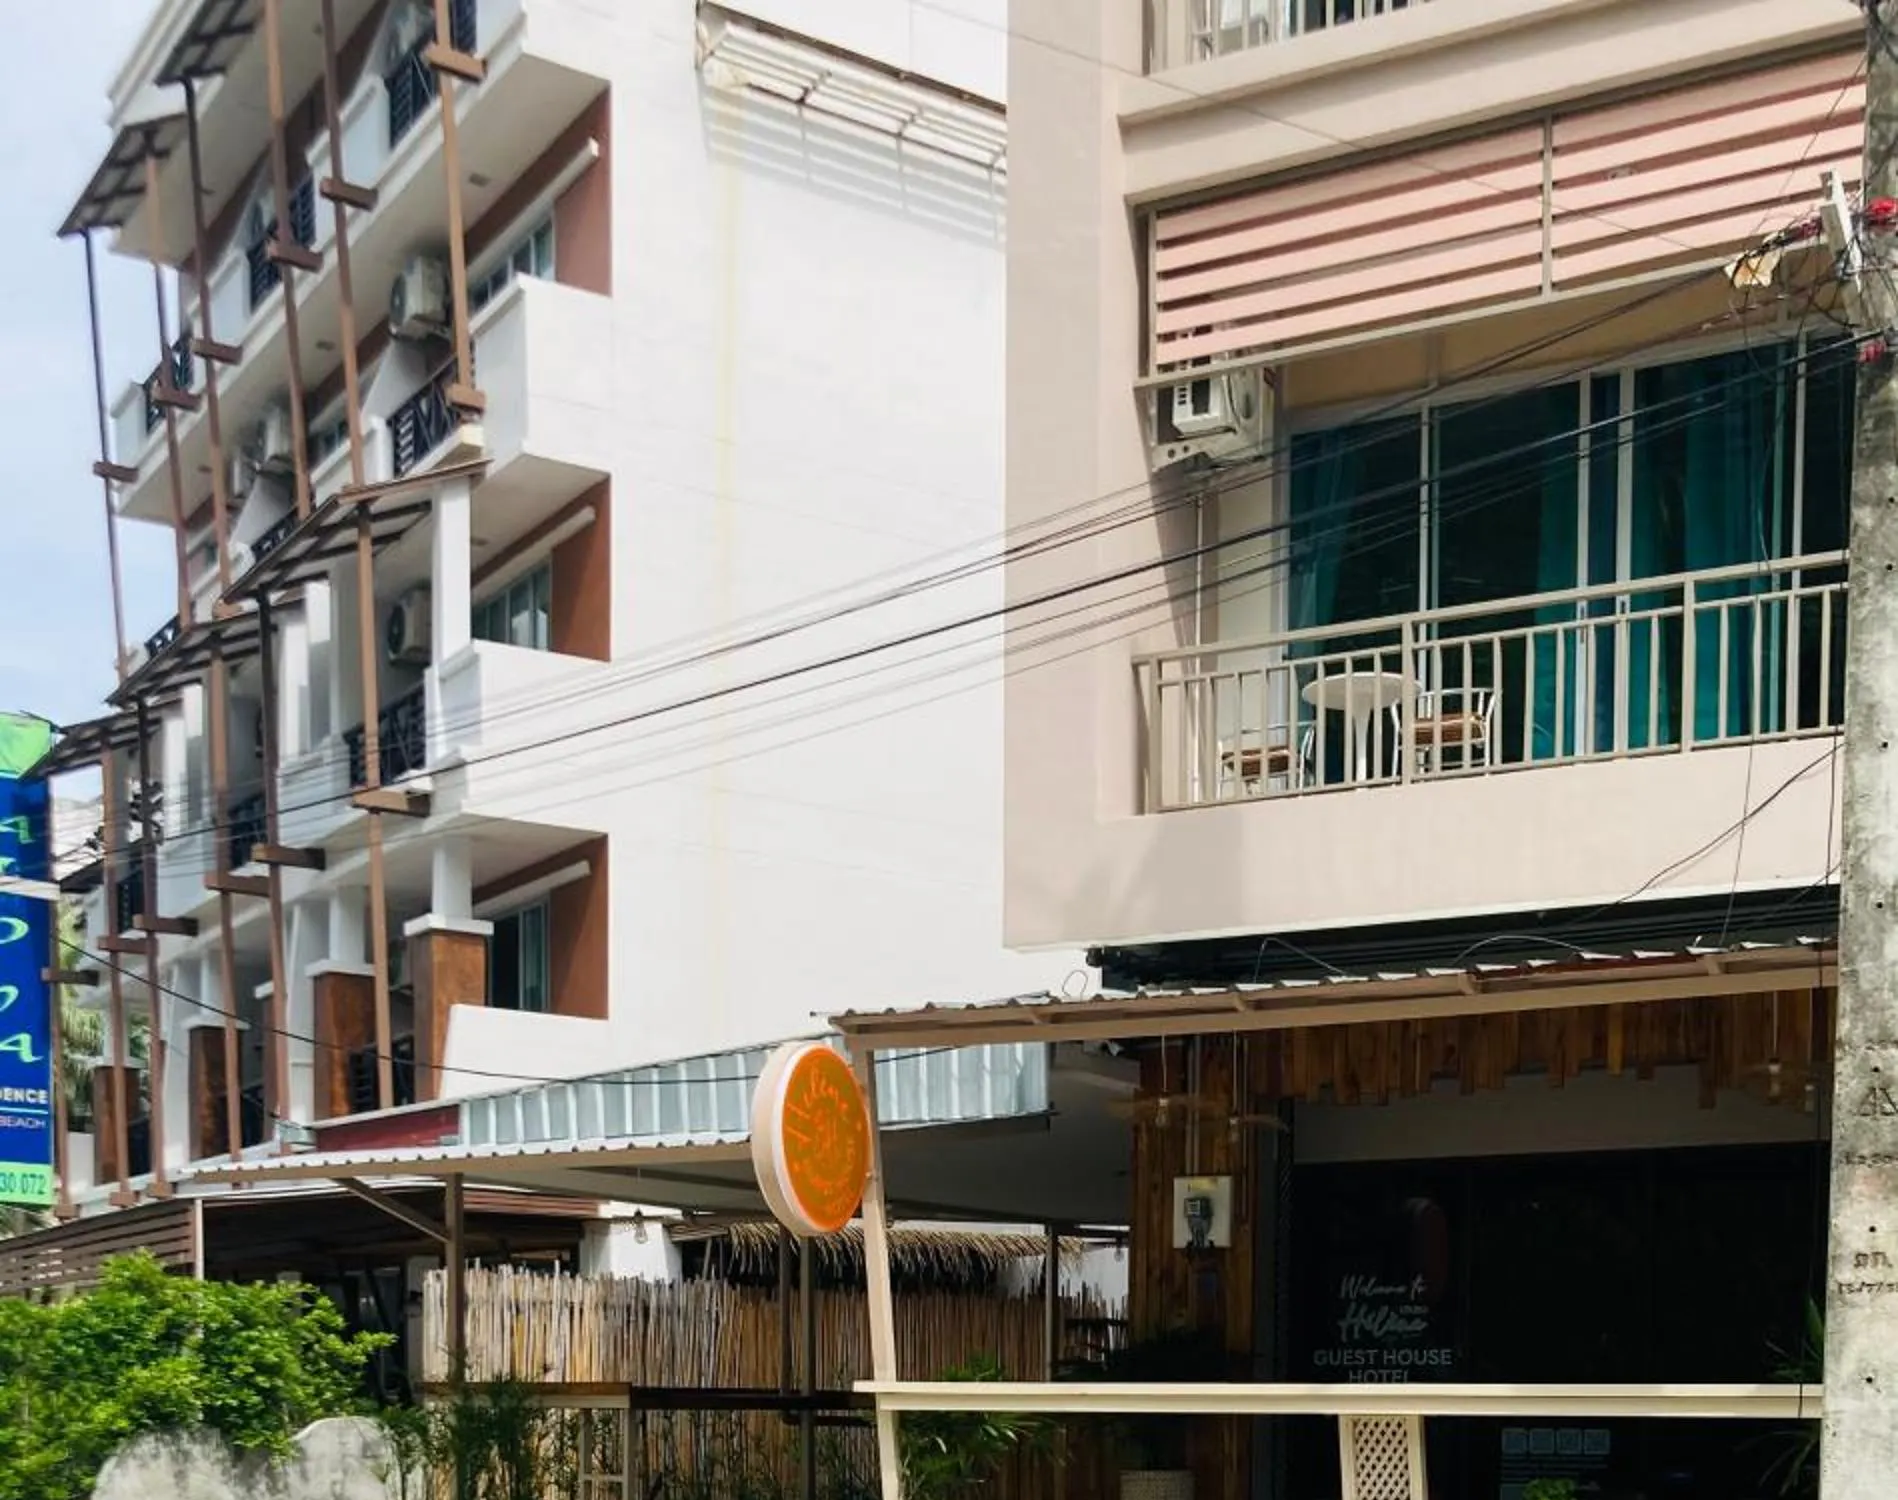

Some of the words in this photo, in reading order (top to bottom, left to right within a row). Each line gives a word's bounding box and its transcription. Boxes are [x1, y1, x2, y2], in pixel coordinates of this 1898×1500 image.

[0, 1087, 48, 1104] ENCE
[1313, 1349, 1378, 1366] GUEST
[1383, 1349, 1453, 1365] HOUSE
